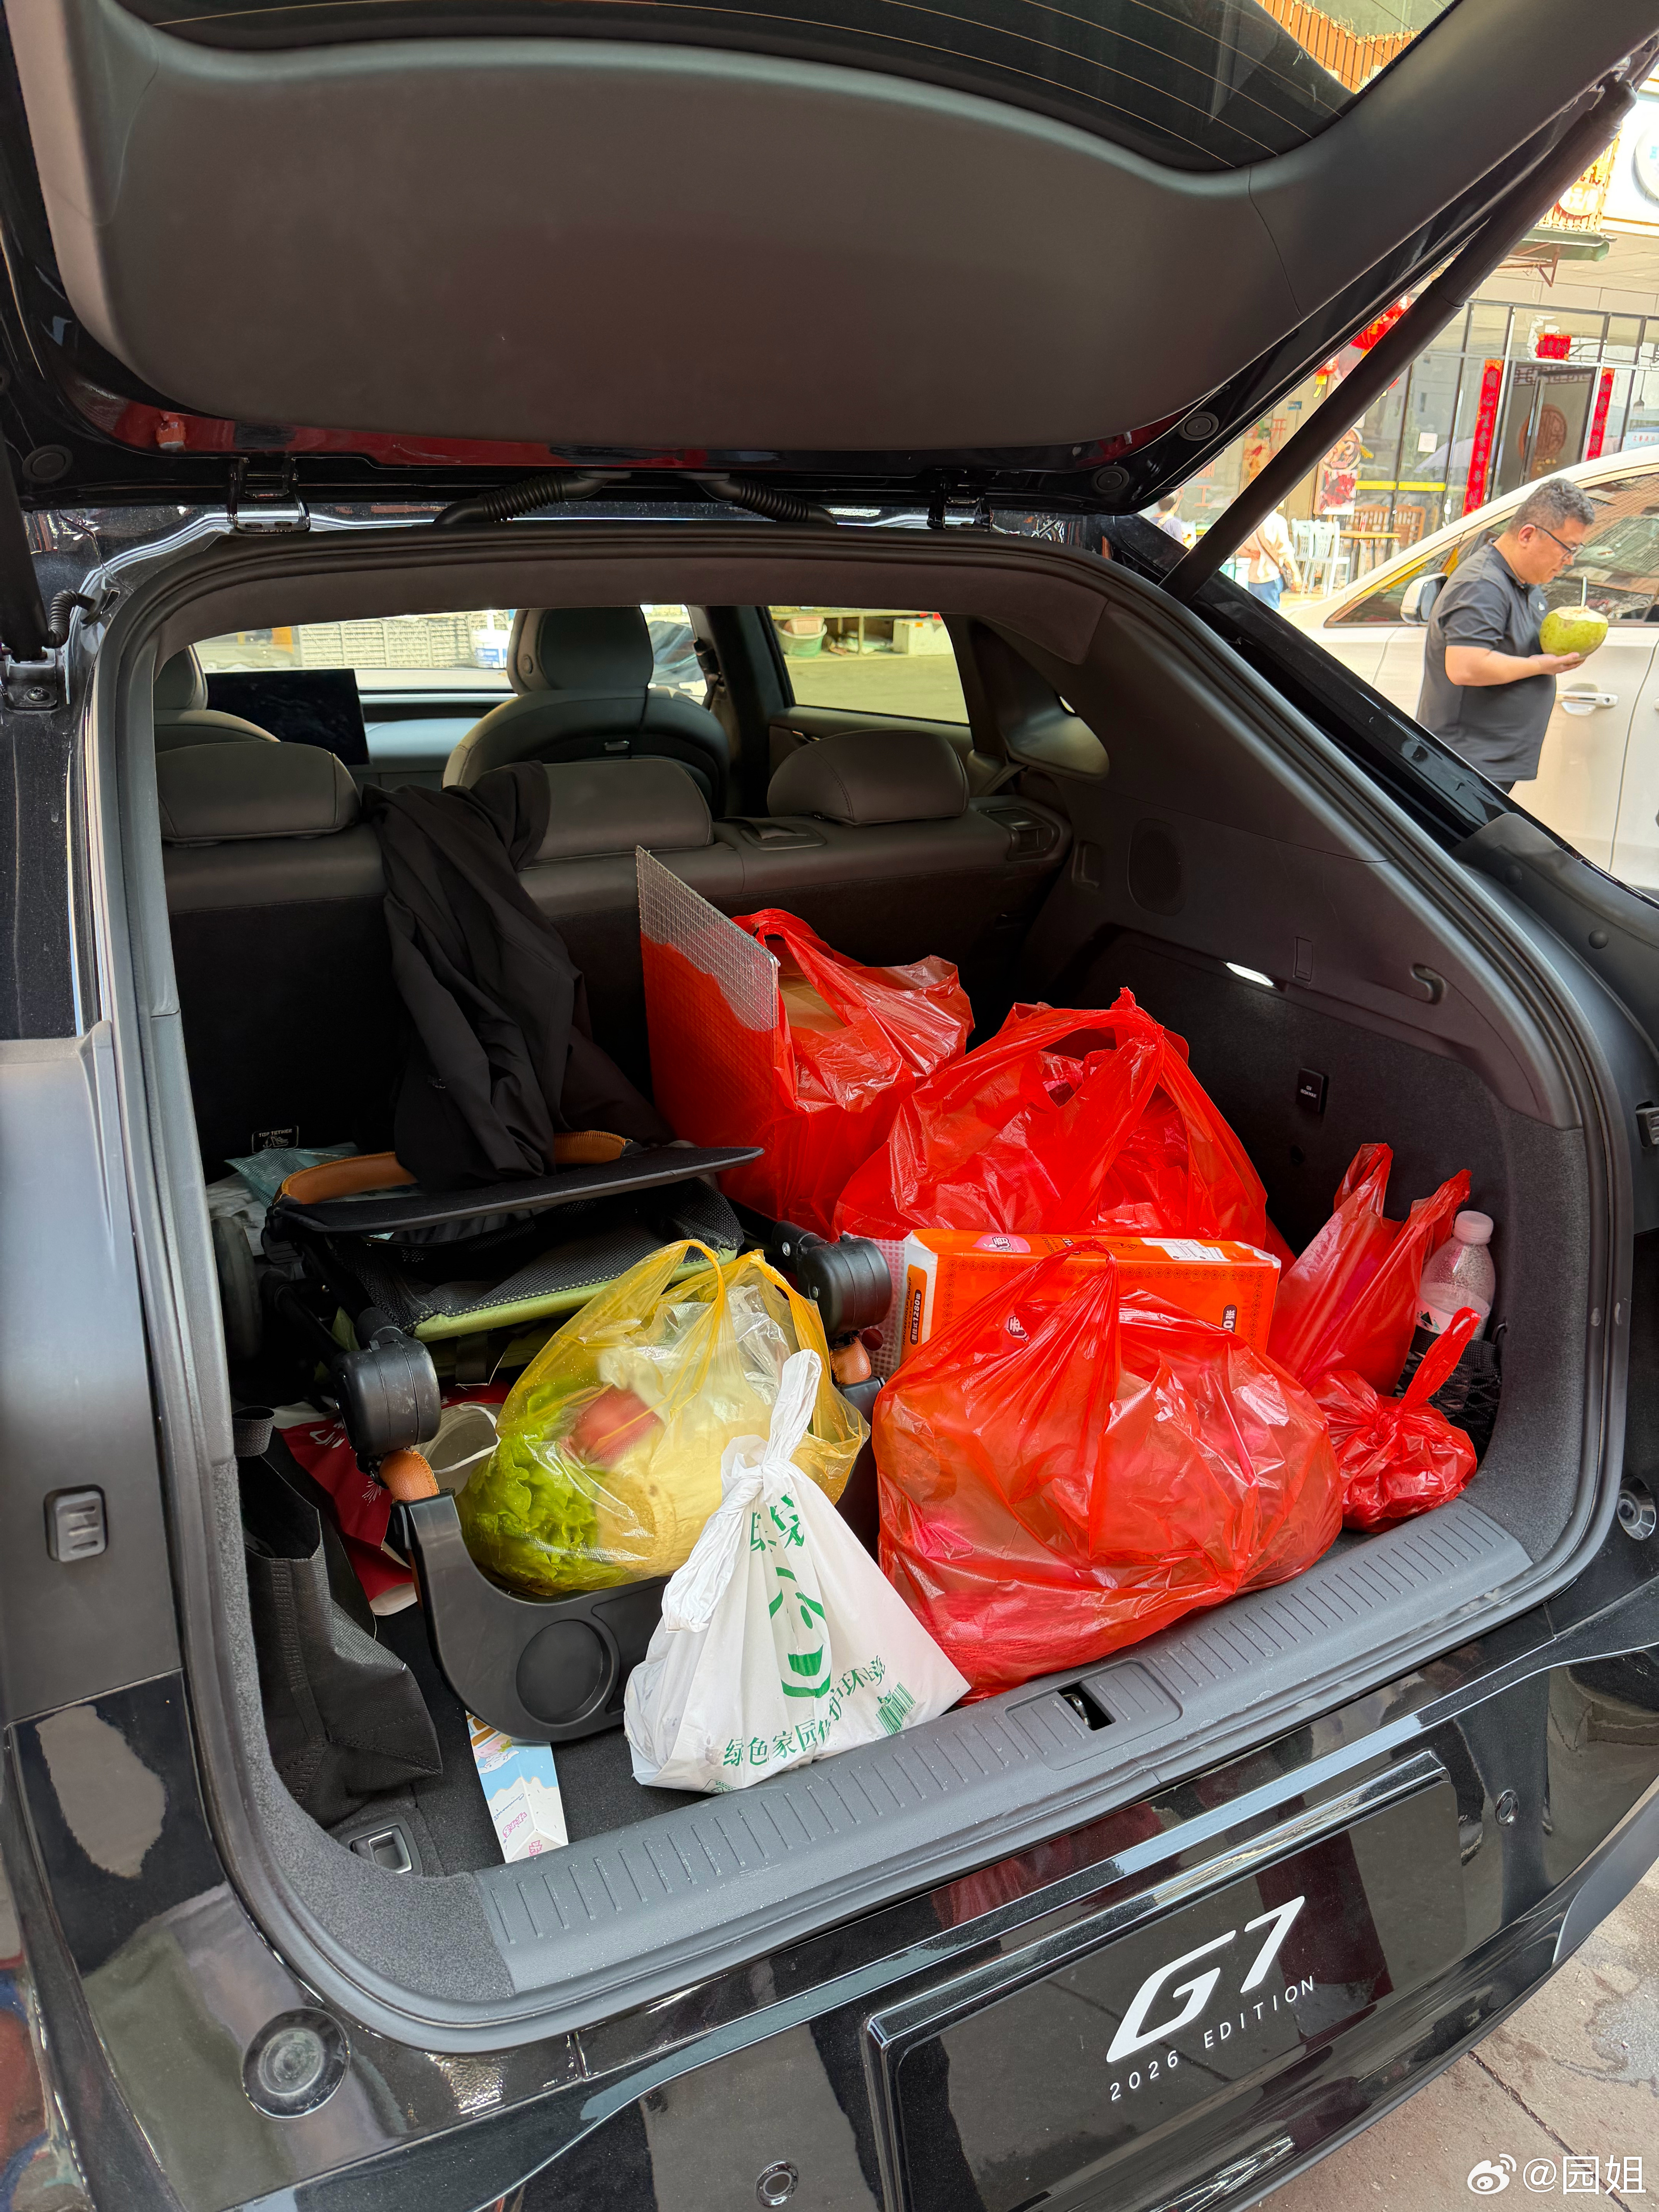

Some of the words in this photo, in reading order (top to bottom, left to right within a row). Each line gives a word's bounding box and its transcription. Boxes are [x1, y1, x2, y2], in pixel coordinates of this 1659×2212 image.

[1223, 1310, 1235, 1329] 0张
[1106, 1895, 1305, 2063] G7
[1109, 2050, 1178, 2101] 2026
[1204, 1975, 1314, 2049] EDITION
